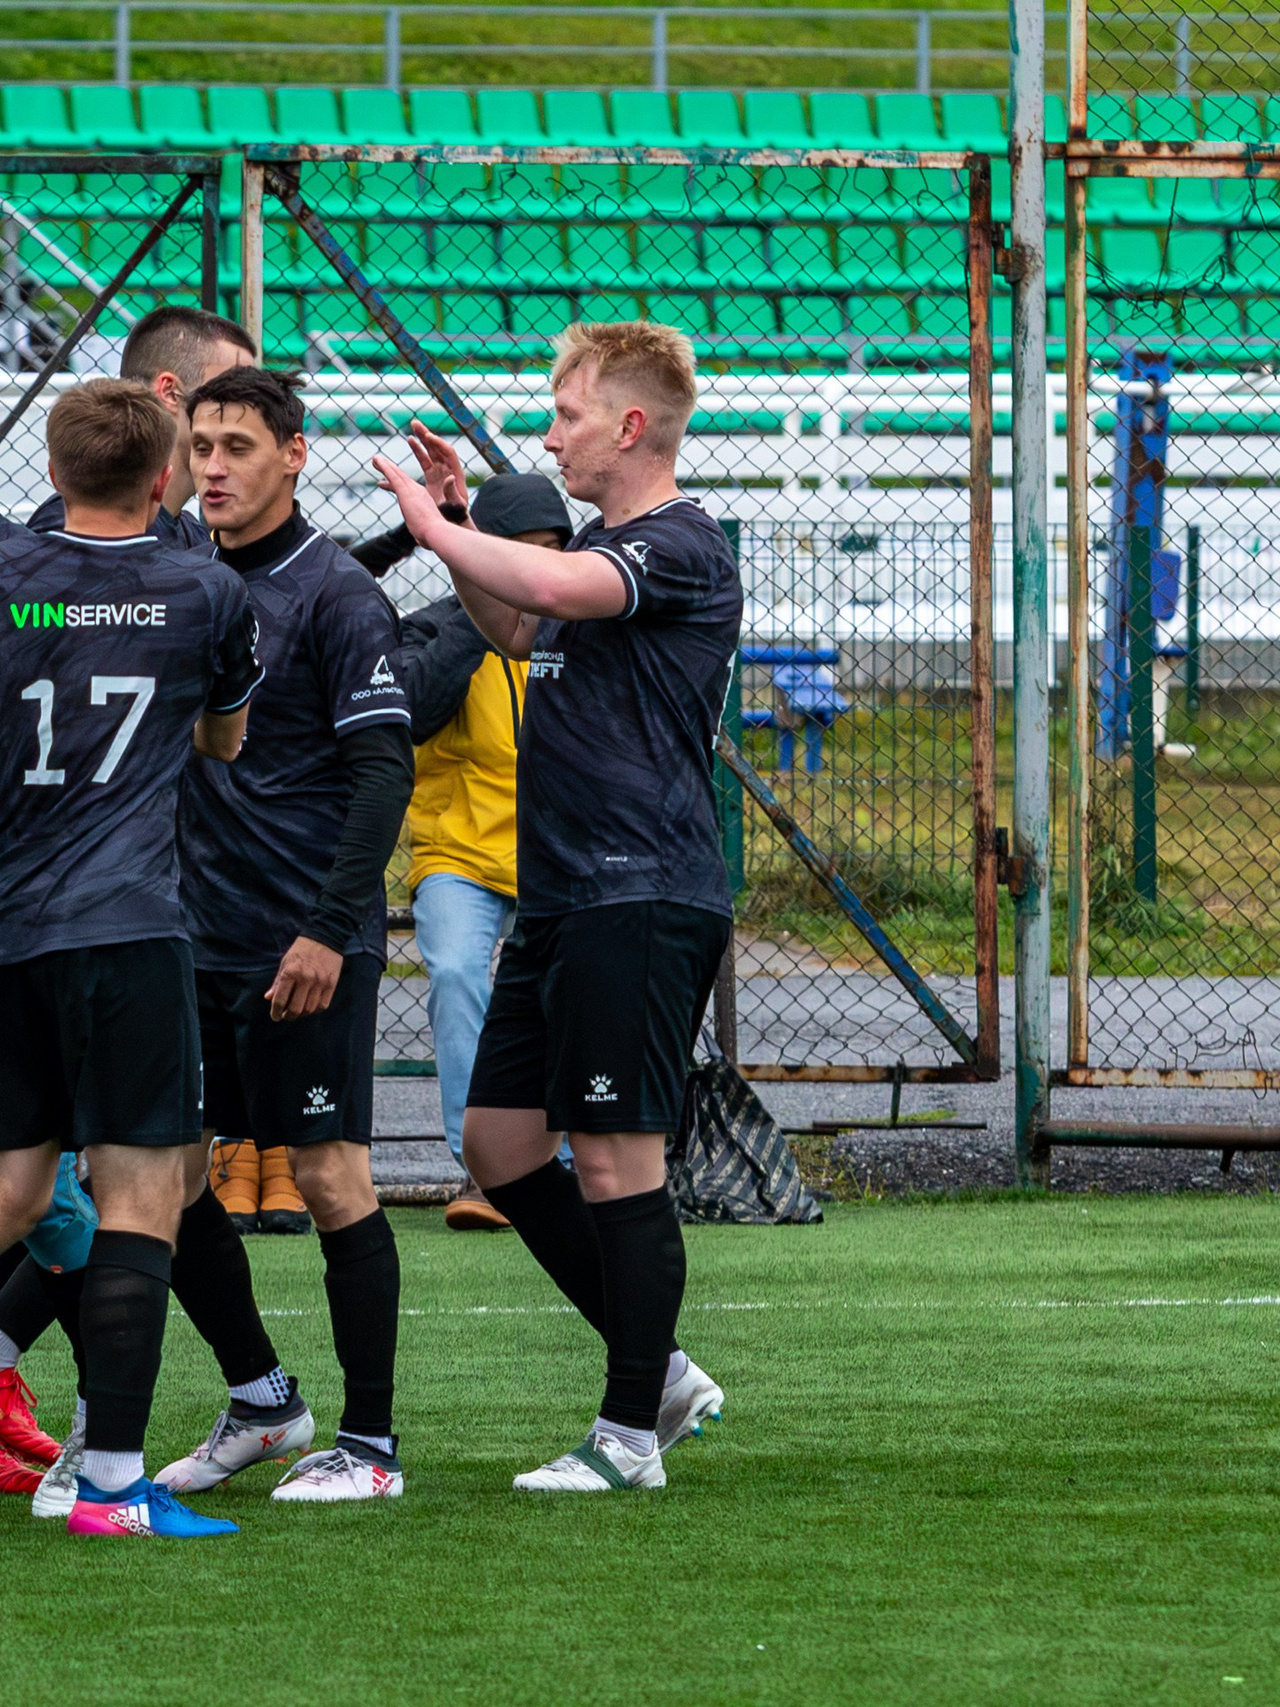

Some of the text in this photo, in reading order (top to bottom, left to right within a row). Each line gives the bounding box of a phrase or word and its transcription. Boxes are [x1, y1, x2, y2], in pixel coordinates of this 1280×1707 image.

[10, 602, 167, 628] VINSERVICE
[21, 675, 156, 785] 17
[584, 1092, 618, 1101] KELME
[303, 1103, 336, 1116] KELME
